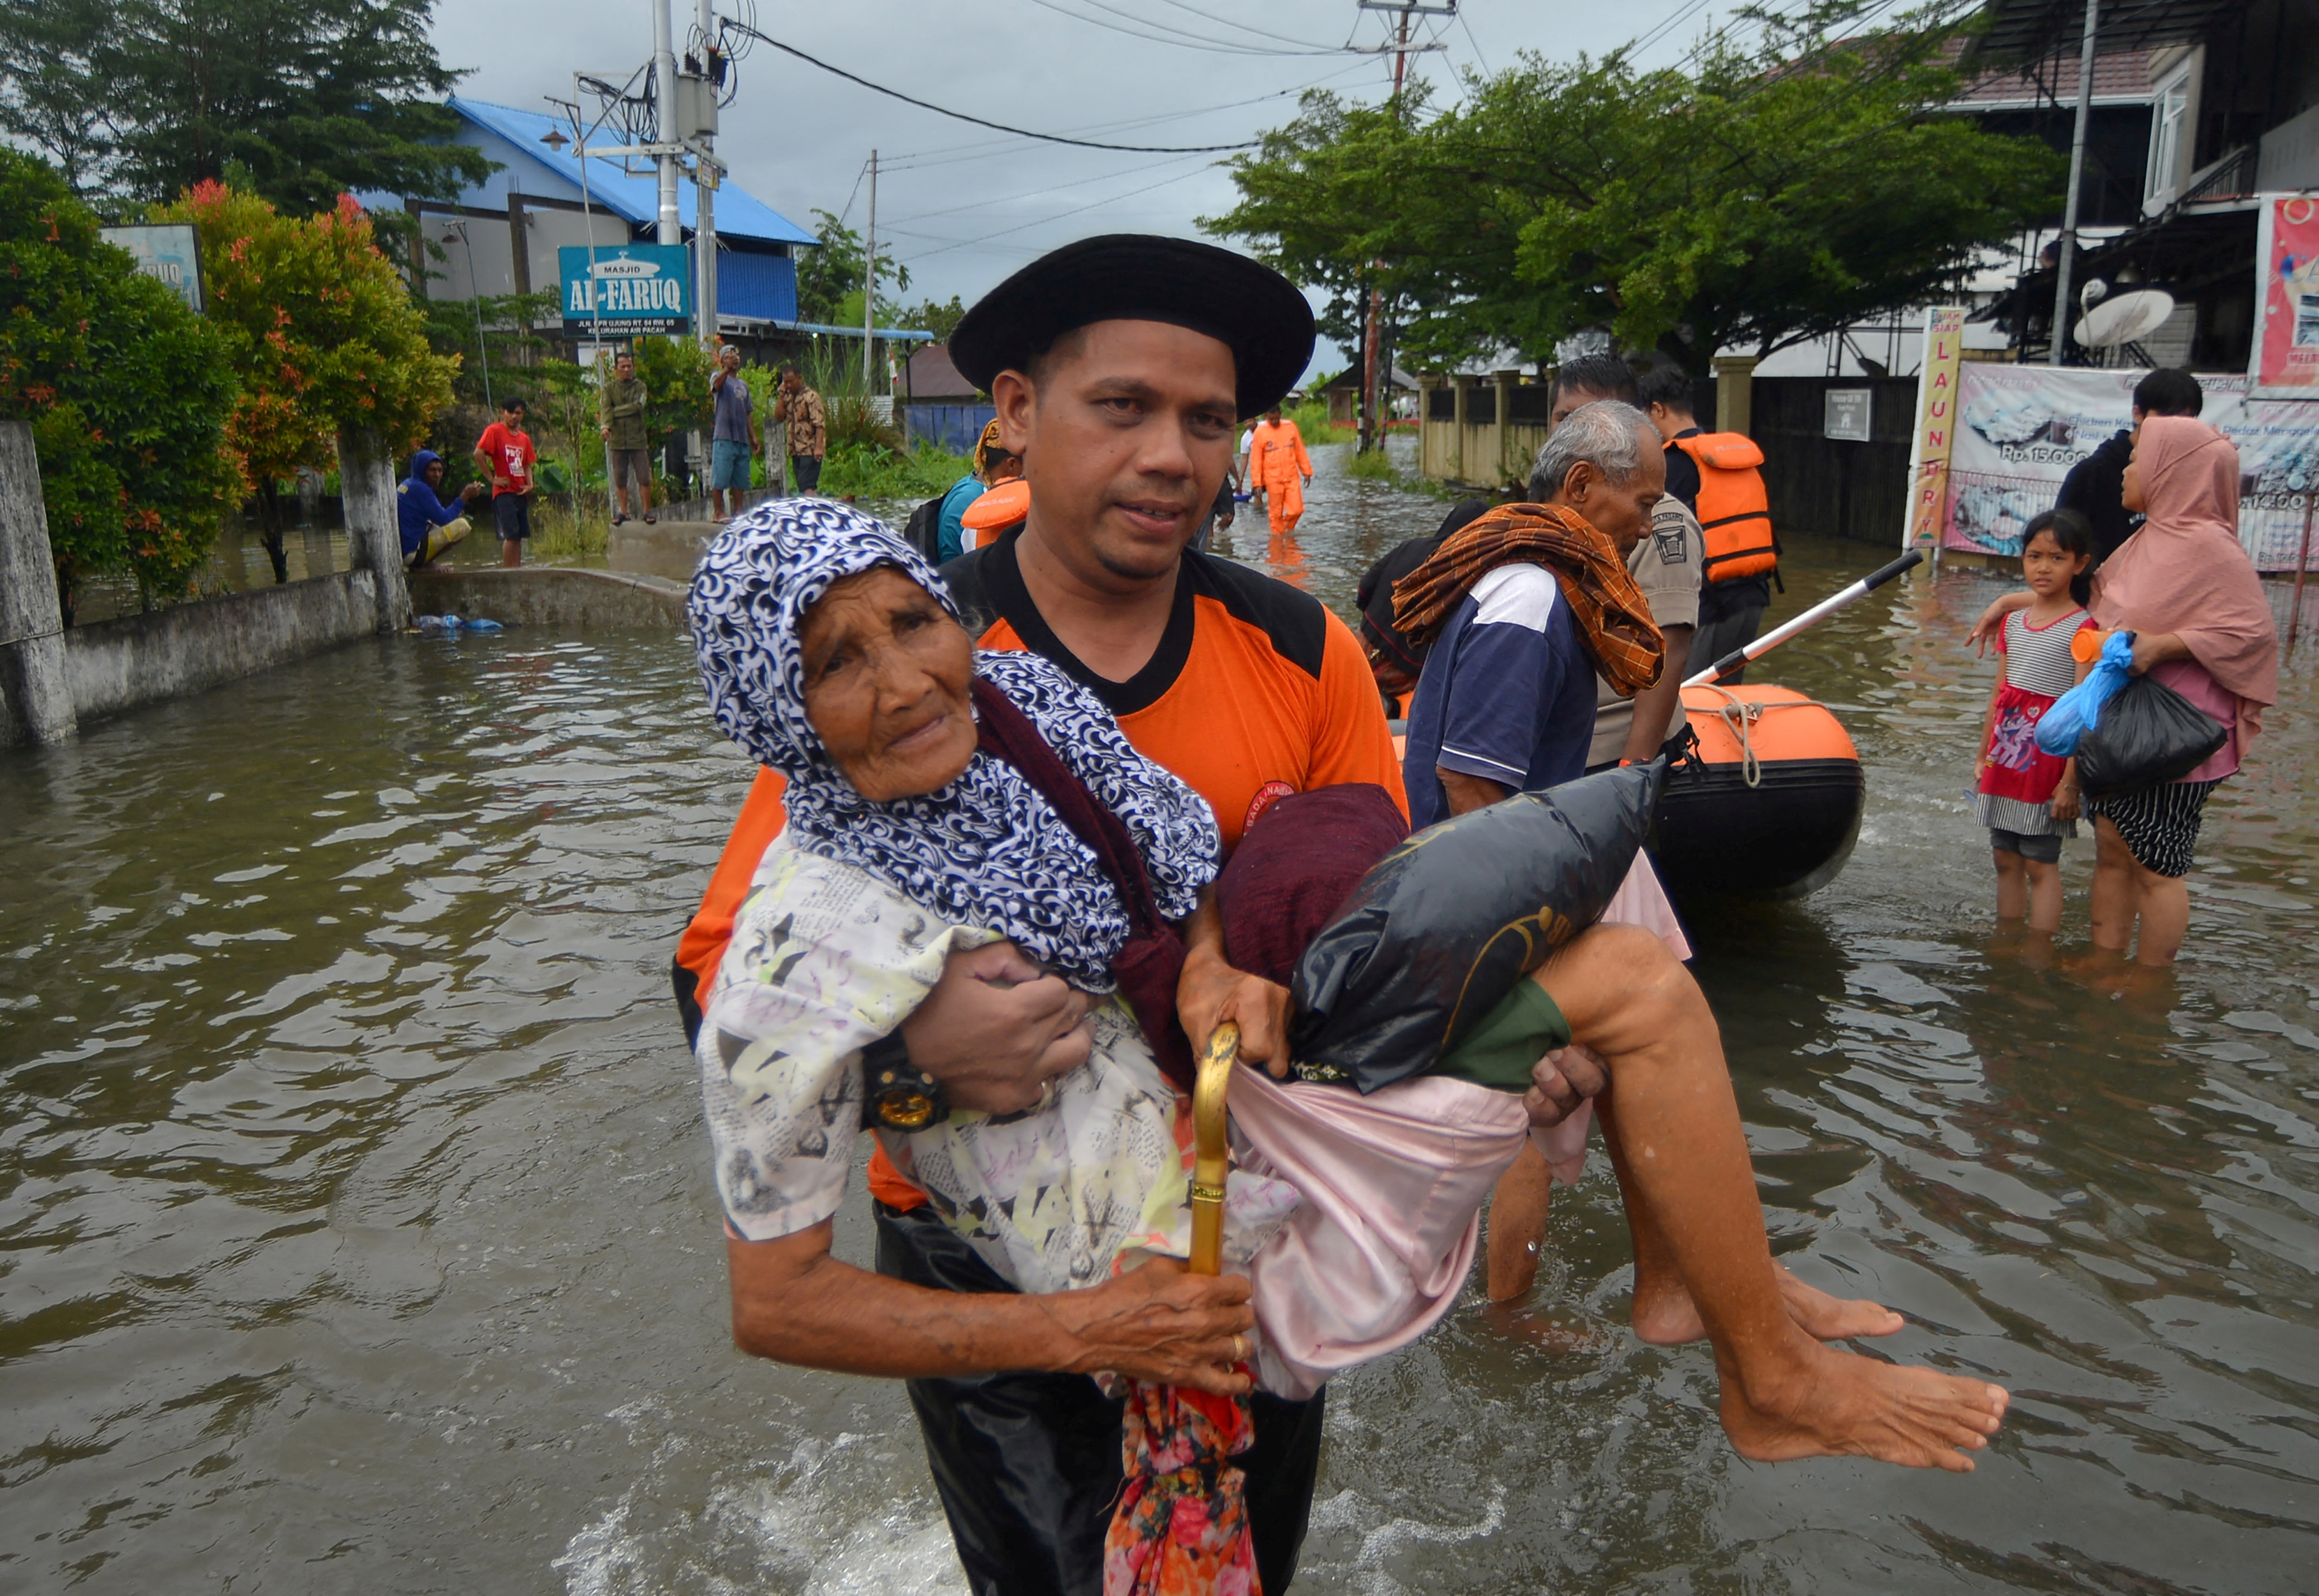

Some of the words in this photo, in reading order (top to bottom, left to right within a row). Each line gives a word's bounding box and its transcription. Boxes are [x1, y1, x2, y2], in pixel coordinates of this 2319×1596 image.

[1933, 323, 1960, 333] SIAP
[1922, 341, 1949, 533] LAUNDRY
[2000, 443, 2029, 464] Rp.
[1247, 793, 1268, 827] BADA
